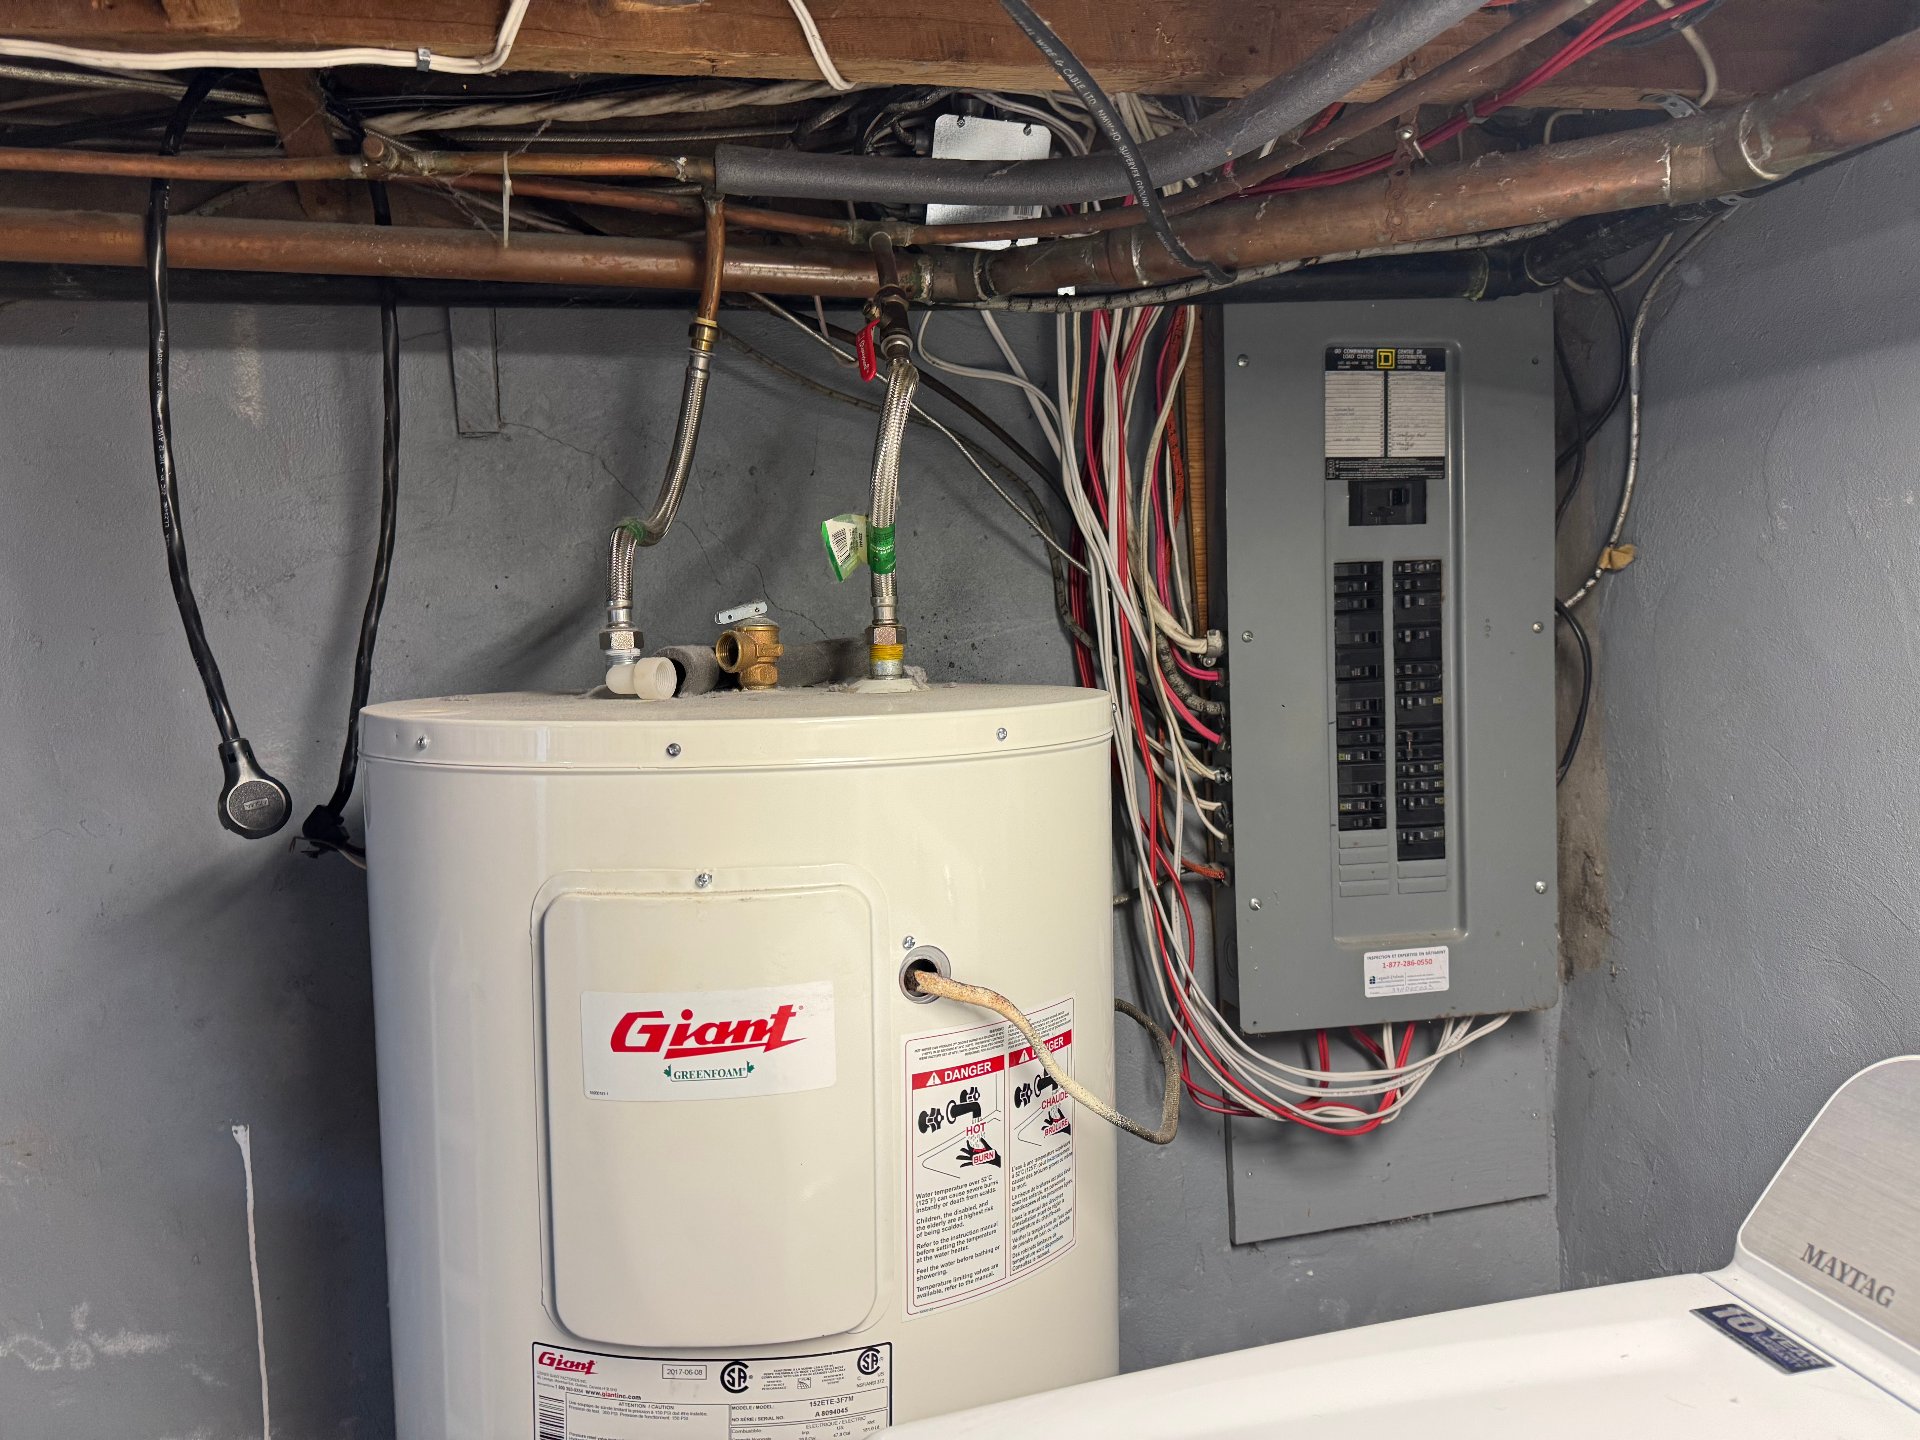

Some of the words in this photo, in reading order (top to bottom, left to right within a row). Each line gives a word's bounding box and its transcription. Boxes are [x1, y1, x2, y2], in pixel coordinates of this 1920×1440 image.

[1036, 39, 1057, 56] WIRE
[1063, 68, 1085, 89] CABLE
[1382, 959, 1433, 968] 1-877-286-0550
[610, 1004, 807, 1060] Giant
[944, 1061, 992, 1082] DANGER
[1041, 1091, 1068, 1110] CHAUDE
[965, 1122, 986, 1136] HOT
[972, 1151, 995, 1164] BURN
[934, 1183, 967, 1195] temperature
[968, 1179, 980, 1187] over
[949, 1190, 965, 1199] cause
[966, 1186, 983, 1194] severe
[984, 1180, 999, 1189] burns
[916, 1203, 941, 1213] instantly
[949, 1197, 965, 1206] death
[965, 1193, 978, 1201] from
[916, 1215, 942, 1225] Children,
[954, 1204, 978, 1215] disabled,
[978, 1200, 989, 1208] and
[916, 1224, 925, 1232] the
[926, 1220, 946, 1229] elderly
[947, 1217, 956, 1225] are
[964, 1209, 983, 1220] highest
[924, 1228, 941, 1237] being
[941, 1222, 964, 1232] scalded.
[917, 1242, 932, 1250] Refer
[950, 1228, 980, 1241] instruction
[980, 1221, 999, 1232] manual
[917, 1248, 935, 1257] before
[936, 1242, 956, 1252] setting
[966, 1229, 997, 1244] temperature
[940, 1260, 956, 1268] water
[956, 1255, 974, 1264] before
[974, 1248, 994, 1258] bathing
[951, 1245, 969, 1254] heater.
[917, 1270, 947, 1281] showering.
[917, 1279, 952, 1293] Temperature
[952, 1272, 973, 1283] limiting
[974, 1266, 990, 1275] valves
[1800, 1243, 1895, 1308] MAYTAG
[916, 1288, 943, 1299] available,
[944, 1283, 957, 1292] refer
[1711, 1306, 1768, 1334] 10
[1770, 1330, 1826, 1366] YEAR
[538, 1351, 598, 1375] Giant
[585, 1390, 642, 1400] www.giantinc.com
[809, 1395, 854, 1407] 152ETE-3F7M
[821, 1407, 849, 1416] 8094045
